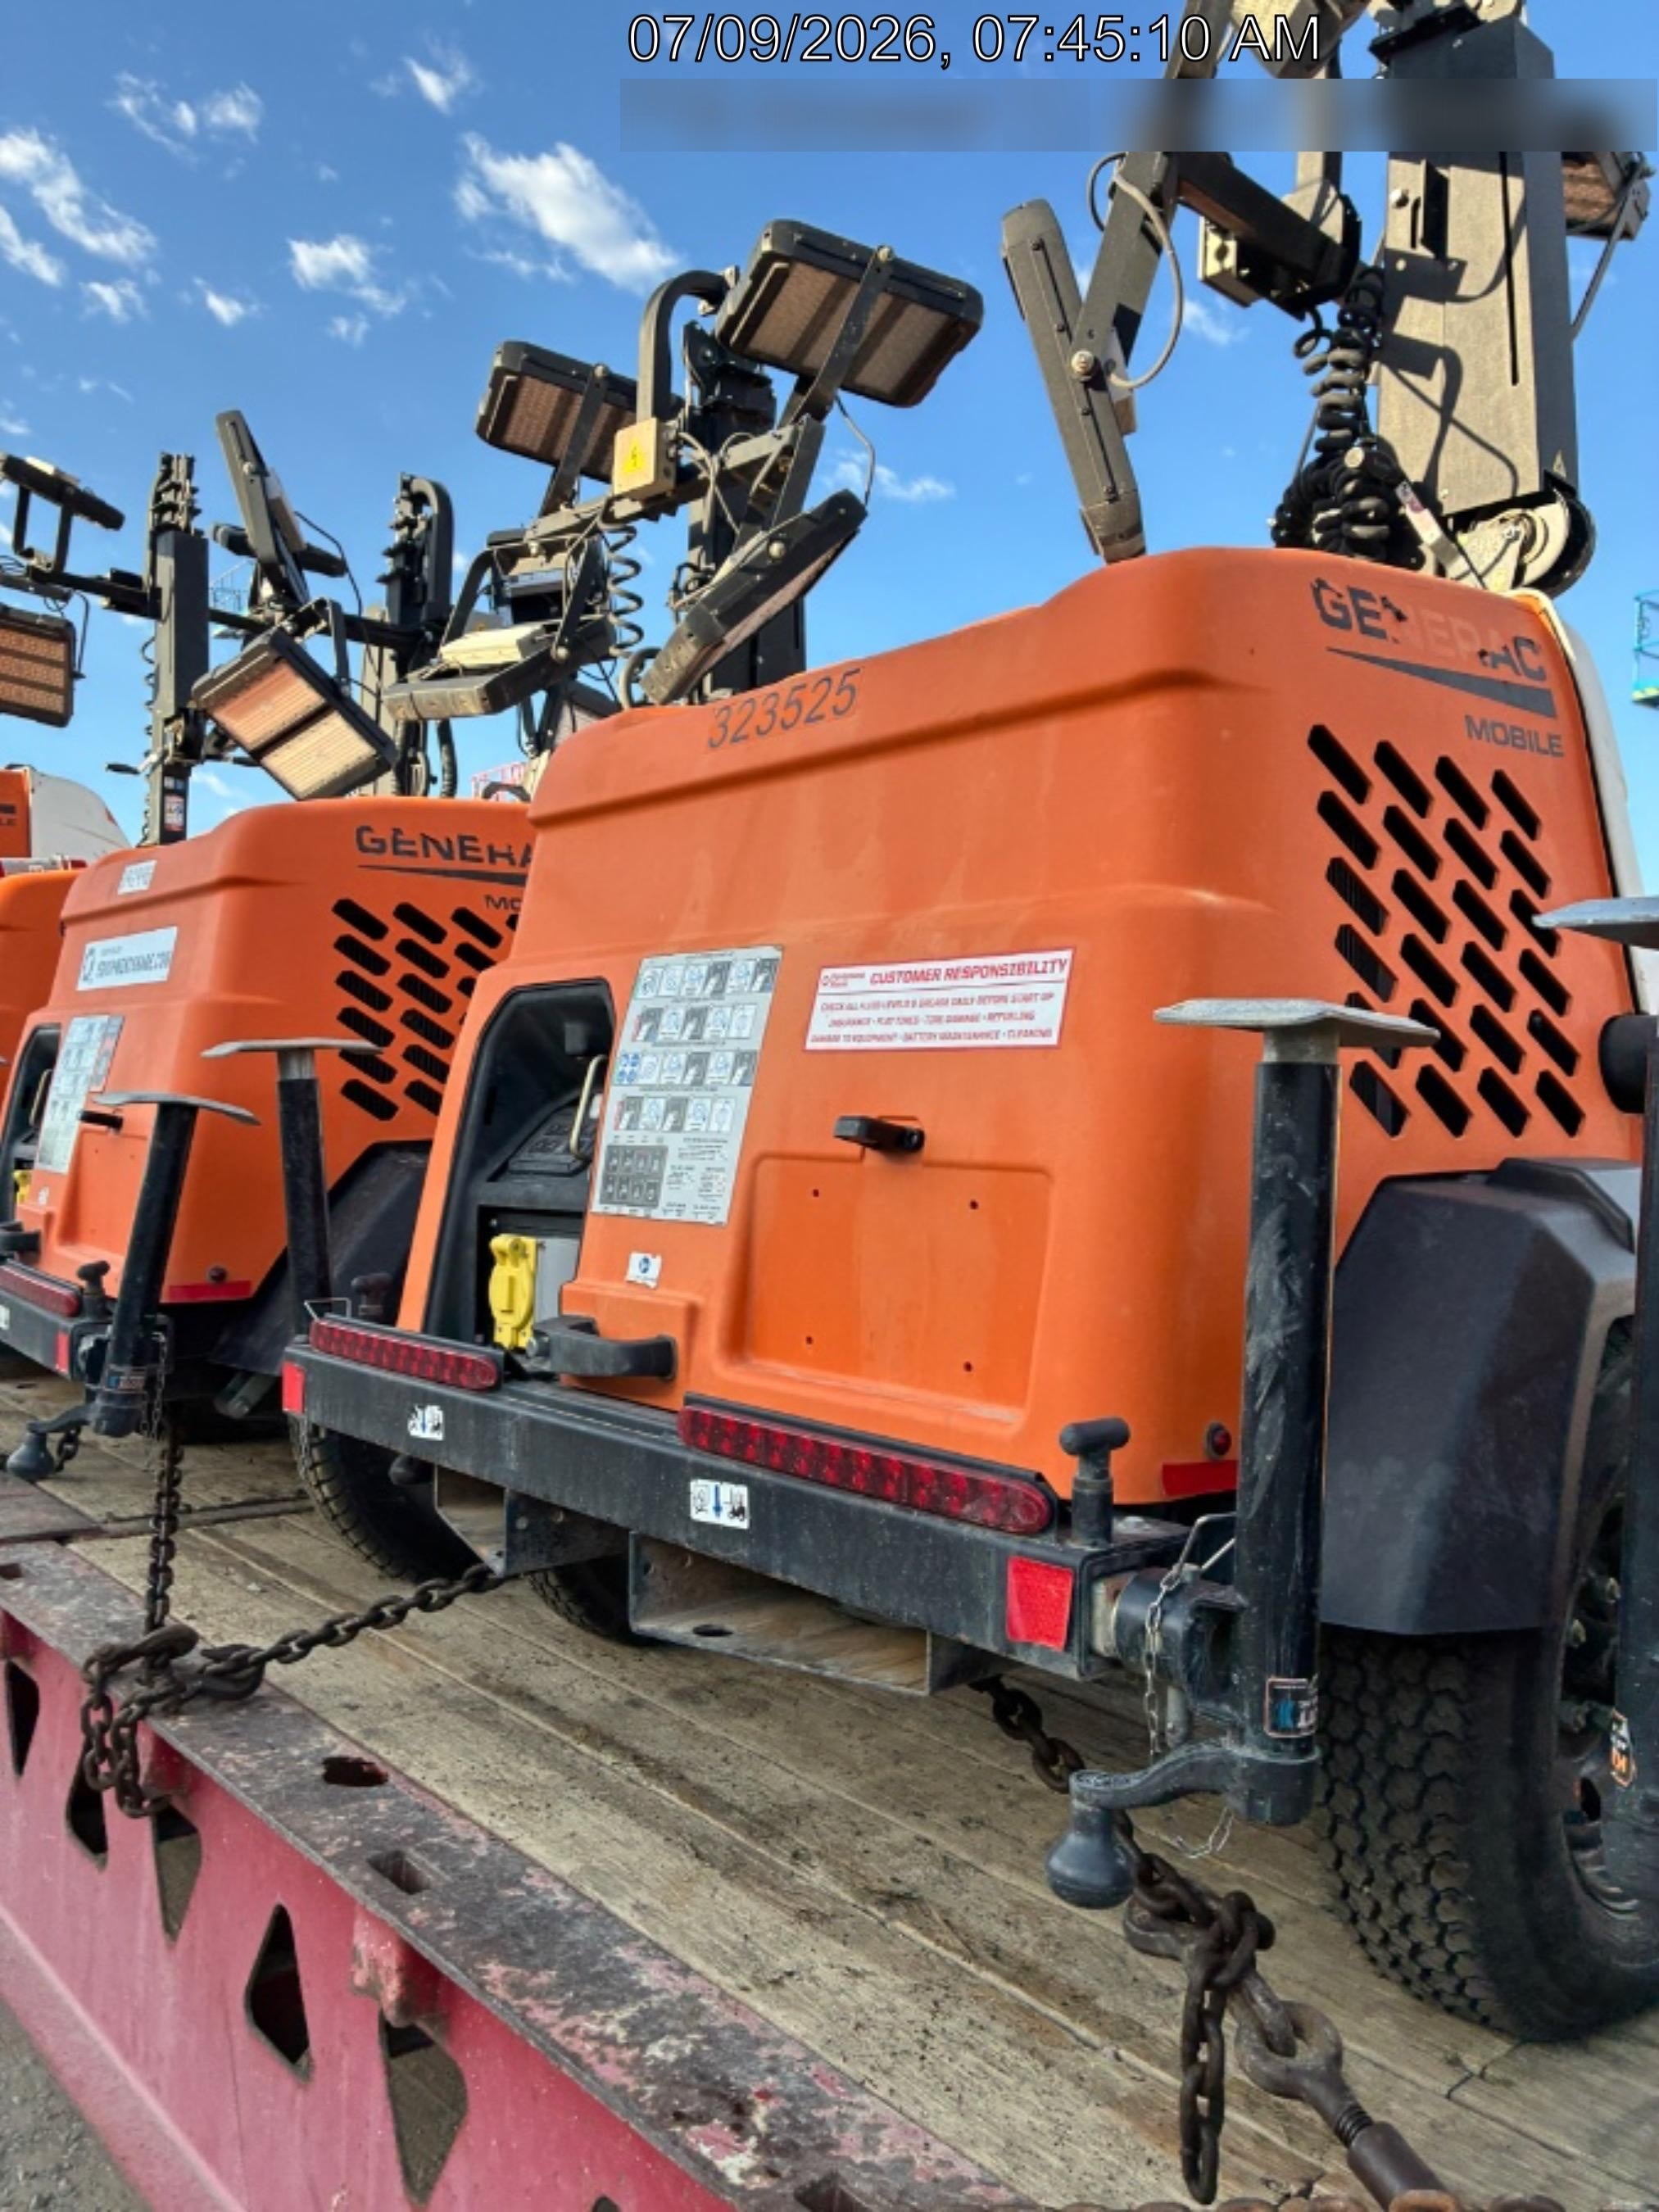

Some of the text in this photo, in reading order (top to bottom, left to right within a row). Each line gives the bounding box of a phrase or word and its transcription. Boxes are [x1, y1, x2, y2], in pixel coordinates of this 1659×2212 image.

[709, 668, 860, 748] 323525
[1465, 715, 1564, 758] MOBILE
[869, 968, 941, 985] CUSTOMER
[944, 959, 1067, 981] RESPONSIBILITY
